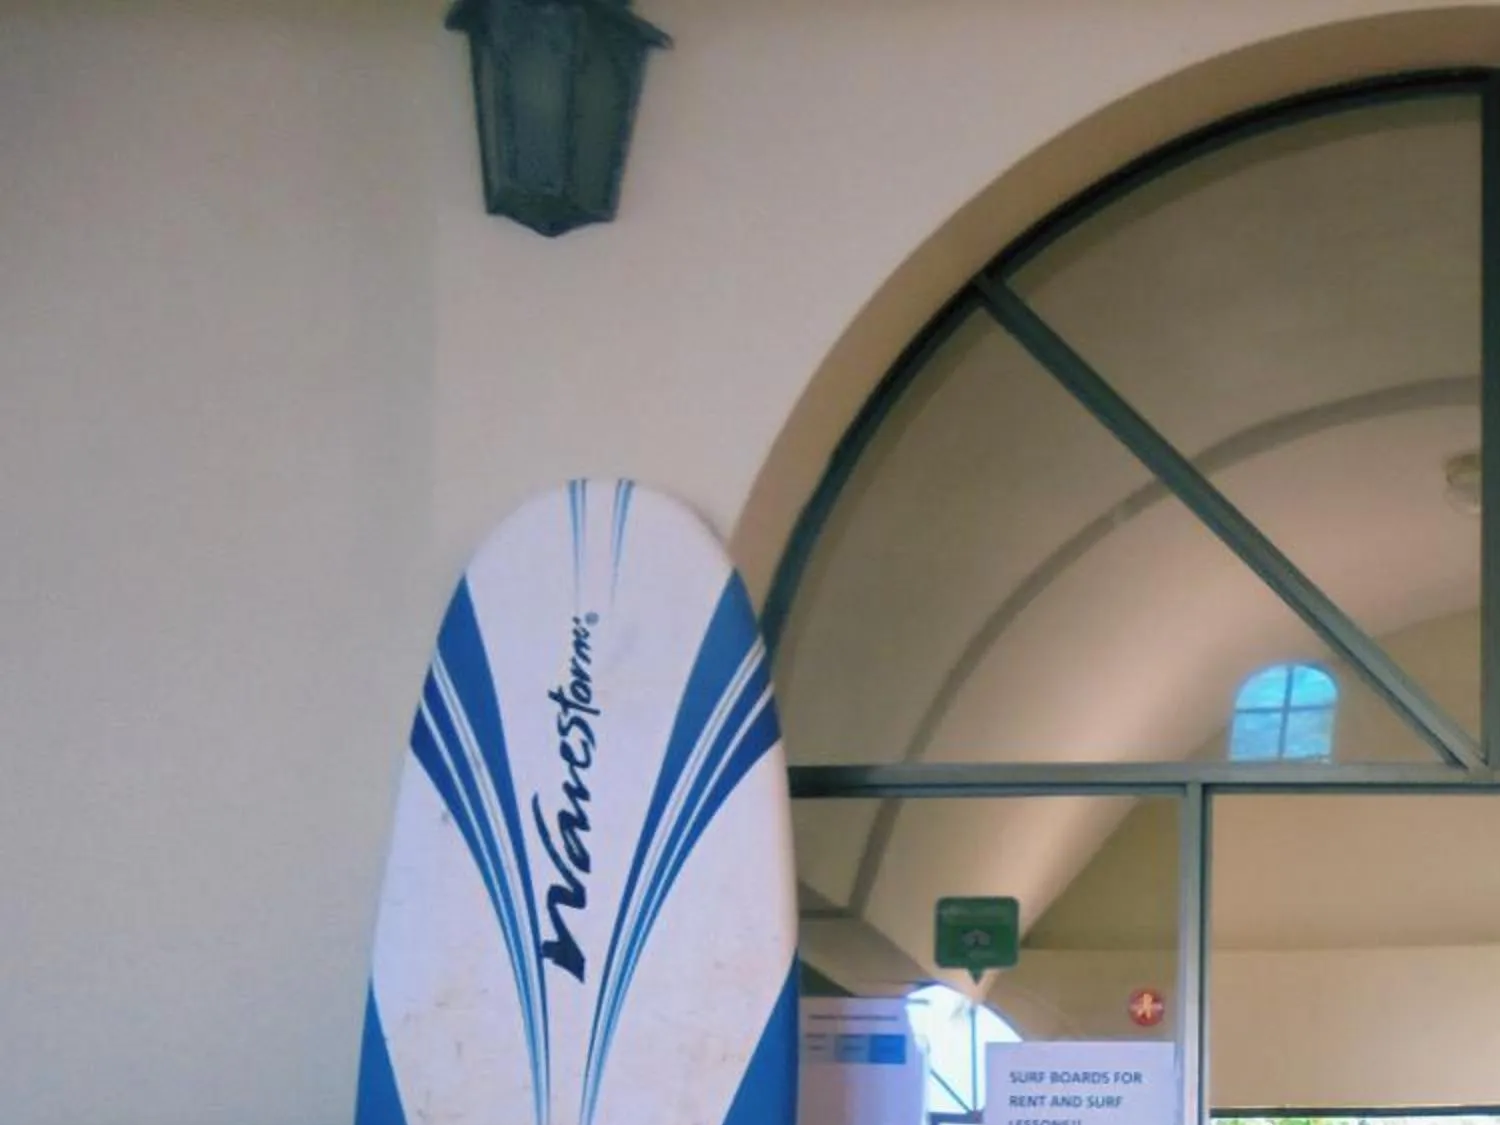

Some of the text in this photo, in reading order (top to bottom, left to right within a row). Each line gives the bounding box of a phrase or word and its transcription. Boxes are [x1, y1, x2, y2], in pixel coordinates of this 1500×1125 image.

[1009, 1070, 1143, 1085] SURF BOARDS FOR
[1008, 1095, 1123, 1109] RENT AND SURF
